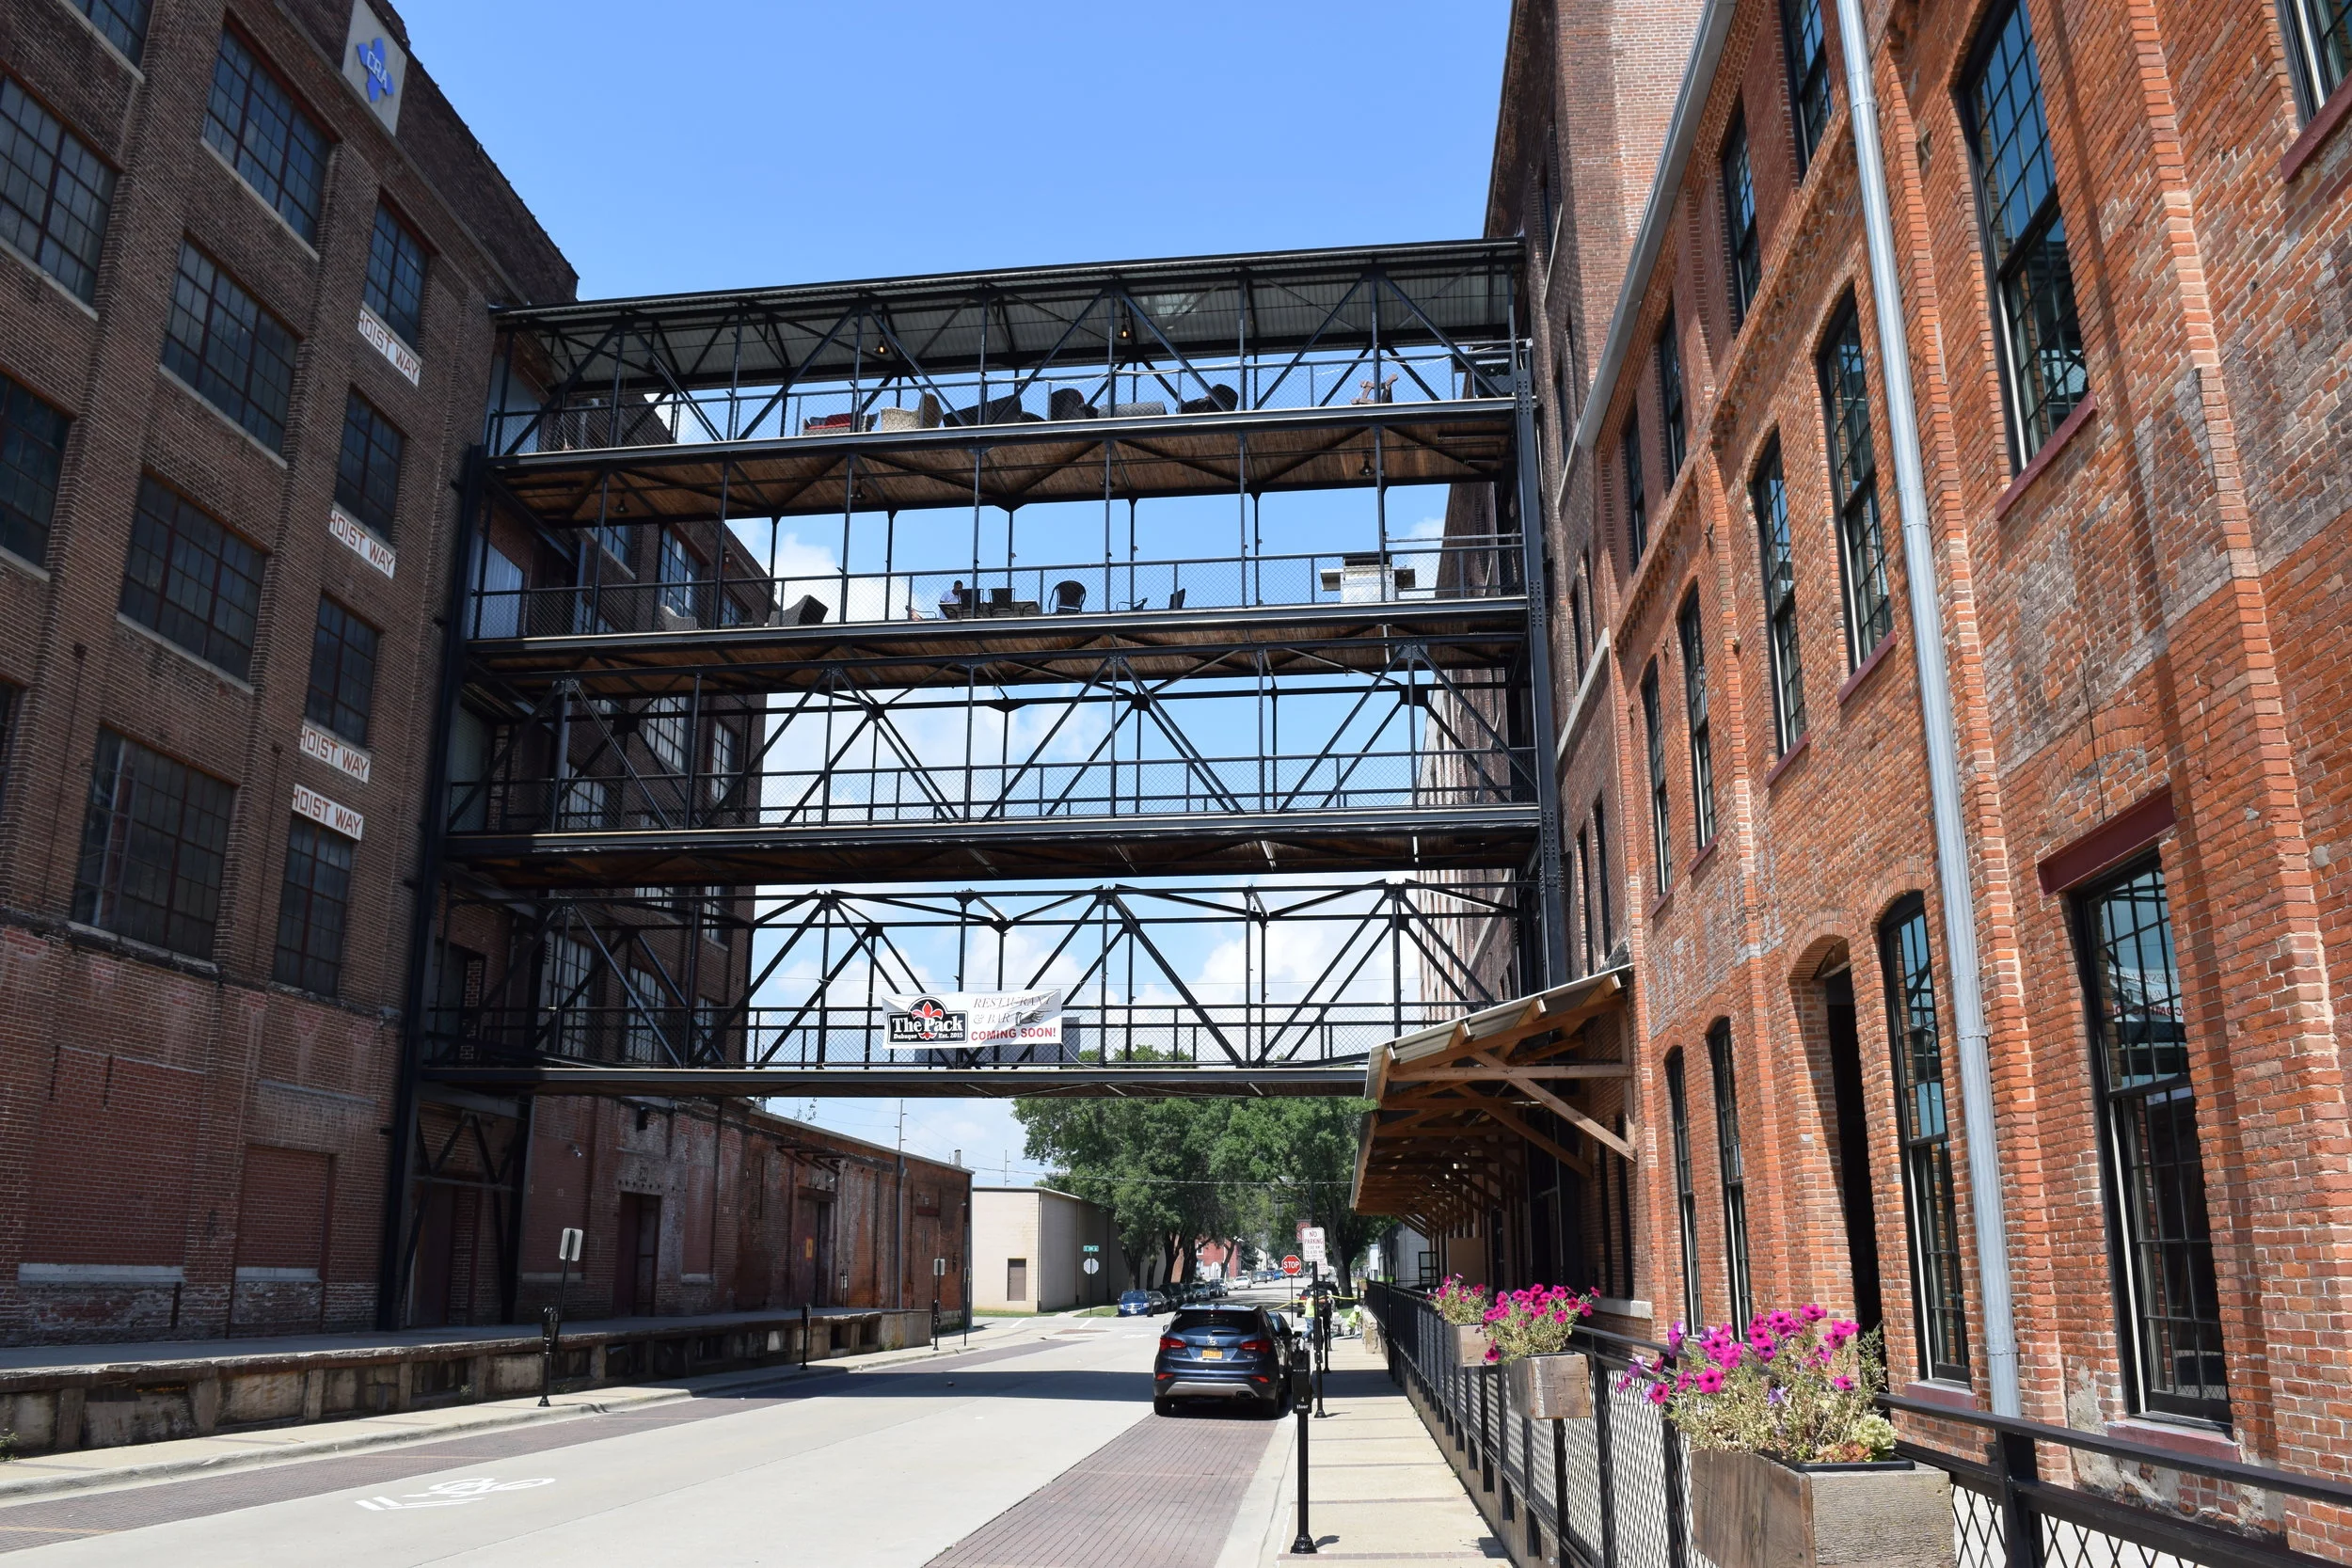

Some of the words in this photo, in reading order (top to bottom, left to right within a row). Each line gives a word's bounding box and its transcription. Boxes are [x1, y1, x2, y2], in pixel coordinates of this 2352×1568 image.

[395, 345, 419, 381] WAY
[369, 540, 394, 573] WAY
[342, 749, 369, 778] WAY
[335, 807, 362, 836] WAY
[973, 995, 1052, 1008] RESTAURANT
[892, 1017, 923, 1033] The
[923, 1015, 963, 1033] Pack
[973, 1013, 984, 1024] &
[987, 1012, 1010, 1024] BAR
[971, 1029, 1017, 1041] COMING
[1021, 1026, 1057, 1038] SOON!
[1283, 1260, 1299, 1269] STOP
